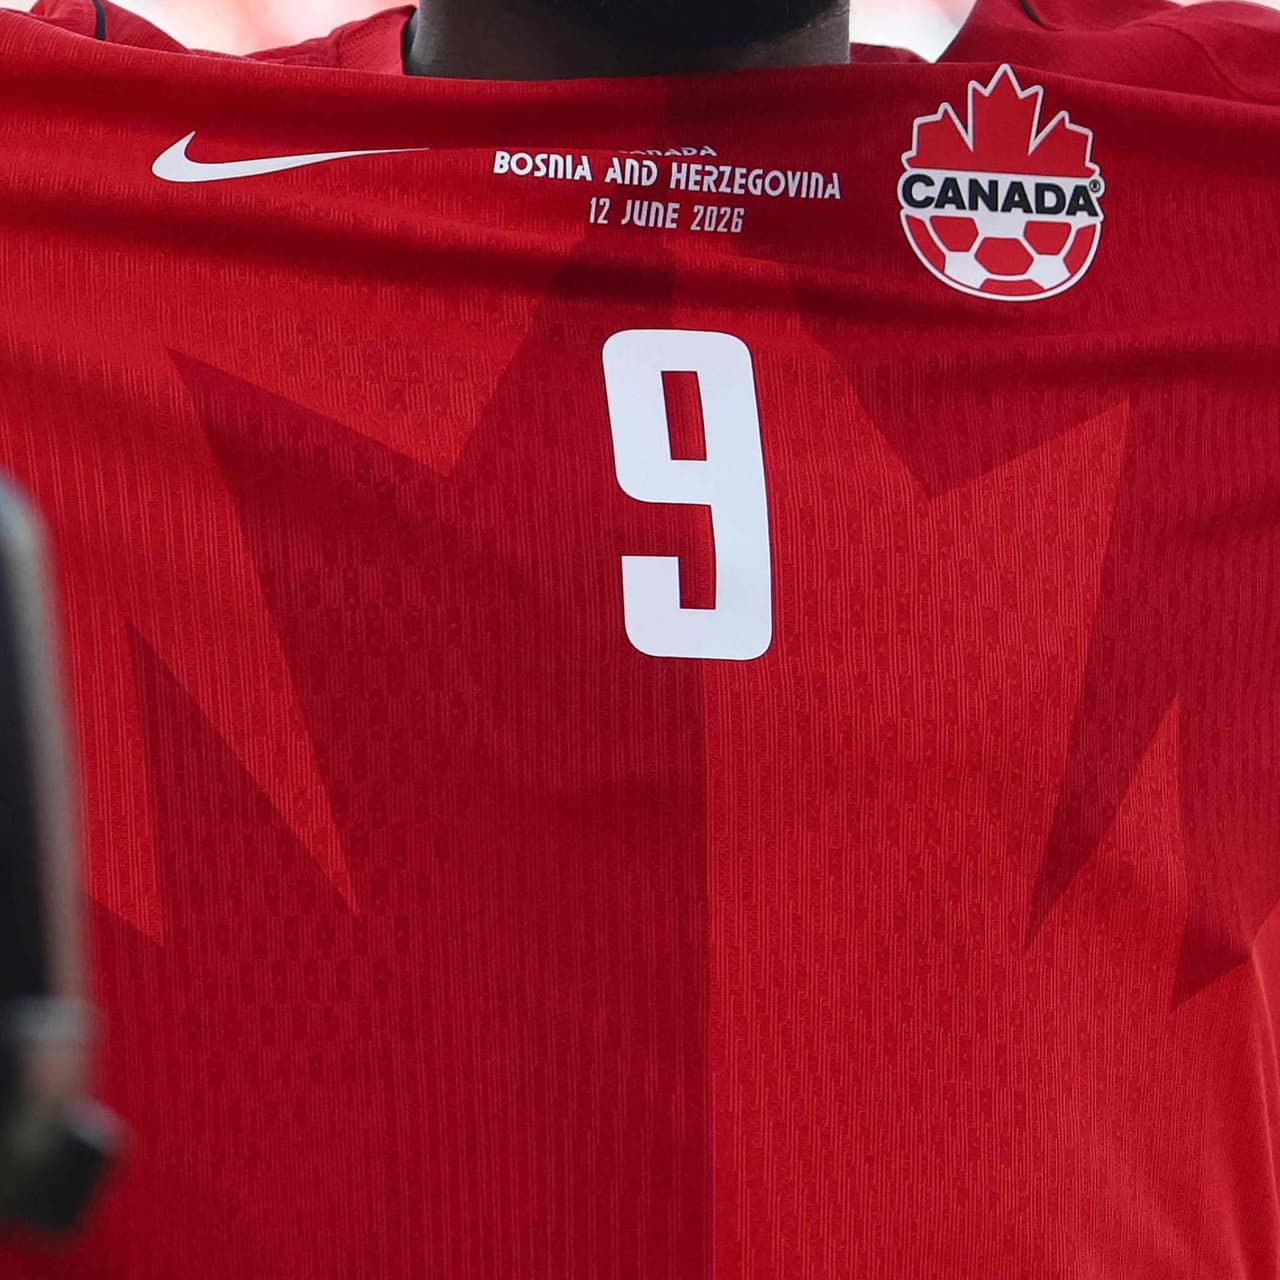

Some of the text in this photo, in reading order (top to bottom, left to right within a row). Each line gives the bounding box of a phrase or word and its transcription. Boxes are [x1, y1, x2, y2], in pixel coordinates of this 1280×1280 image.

[493, 150, 842, 200] BOSNIA AND HERZEGOVINA
[901, 173, 1099, 217] CANADA
[588, 197, 746, 233] 12 JUNE 2026
[601, 328, 773, 662] 9
